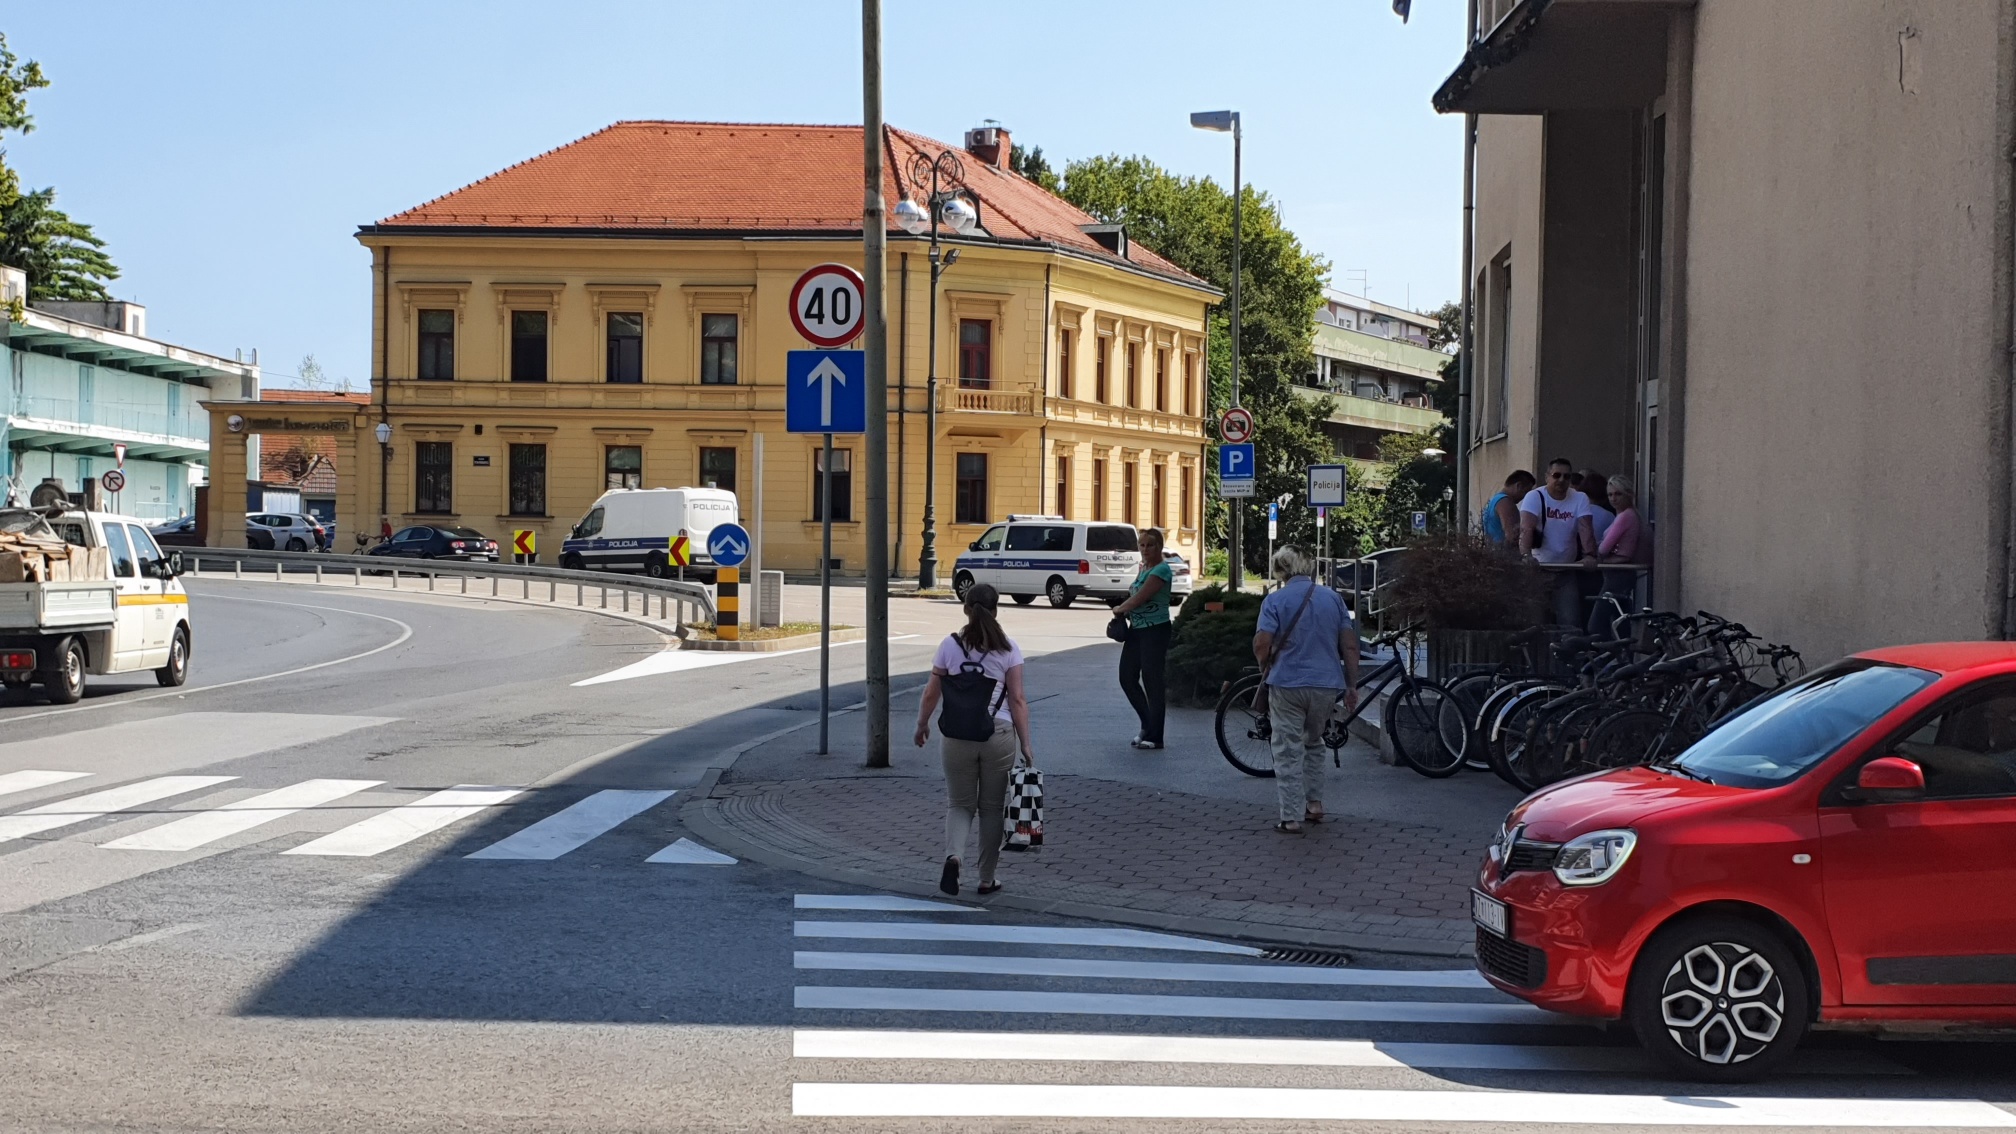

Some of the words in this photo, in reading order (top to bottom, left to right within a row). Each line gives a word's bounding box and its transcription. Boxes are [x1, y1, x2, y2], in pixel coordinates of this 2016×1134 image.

[804, 287, 850, 325] 40
[1229, 451, 1244, 472] P
[1313, 481, 1341, 491] Policija
[693, 503, 731, 511] POLICIJA
[1415, 514, 1423, 525] P
[608, 540, 639, 548] POLICIJA
[1003, 560, 1031, 568] POLICIJA
